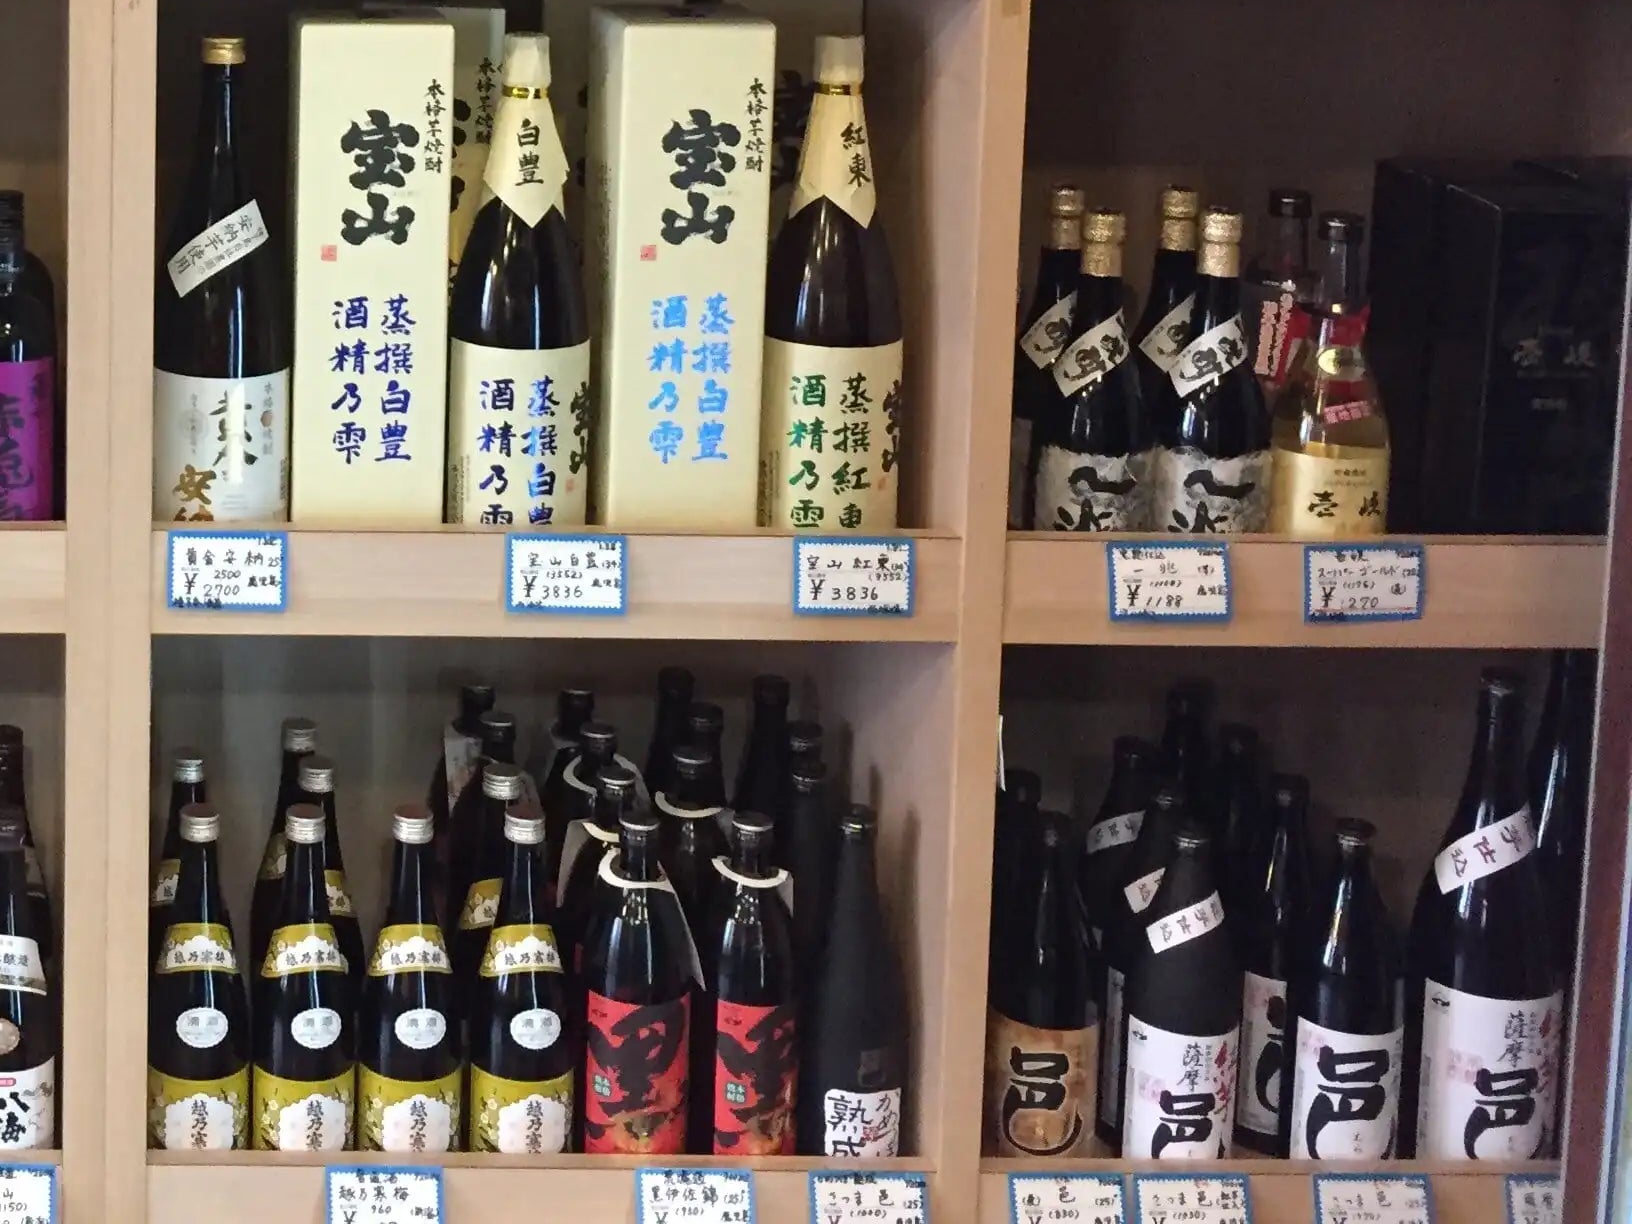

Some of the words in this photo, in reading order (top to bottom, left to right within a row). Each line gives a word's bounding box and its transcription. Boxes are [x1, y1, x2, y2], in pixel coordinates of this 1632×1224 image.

[340, 109, 419, 246] 宝山
[424, 79, 445, 173] 本格芋焼酎
[517, 119, 544, 186] 白豊
[662, 109, 741, 246] 宝山
[745, 78, 768, 173] 本格芋焼酎
[840, 122, 871, 188] 紅東
[330, 297, 368, 464] 酒精乃雫
[374, 295, 416, 463] 蒸撰白豊
[648, 295, 687, 464] 酒精乃雫
[692, 293, 735, 462] 蒸撰白豊
